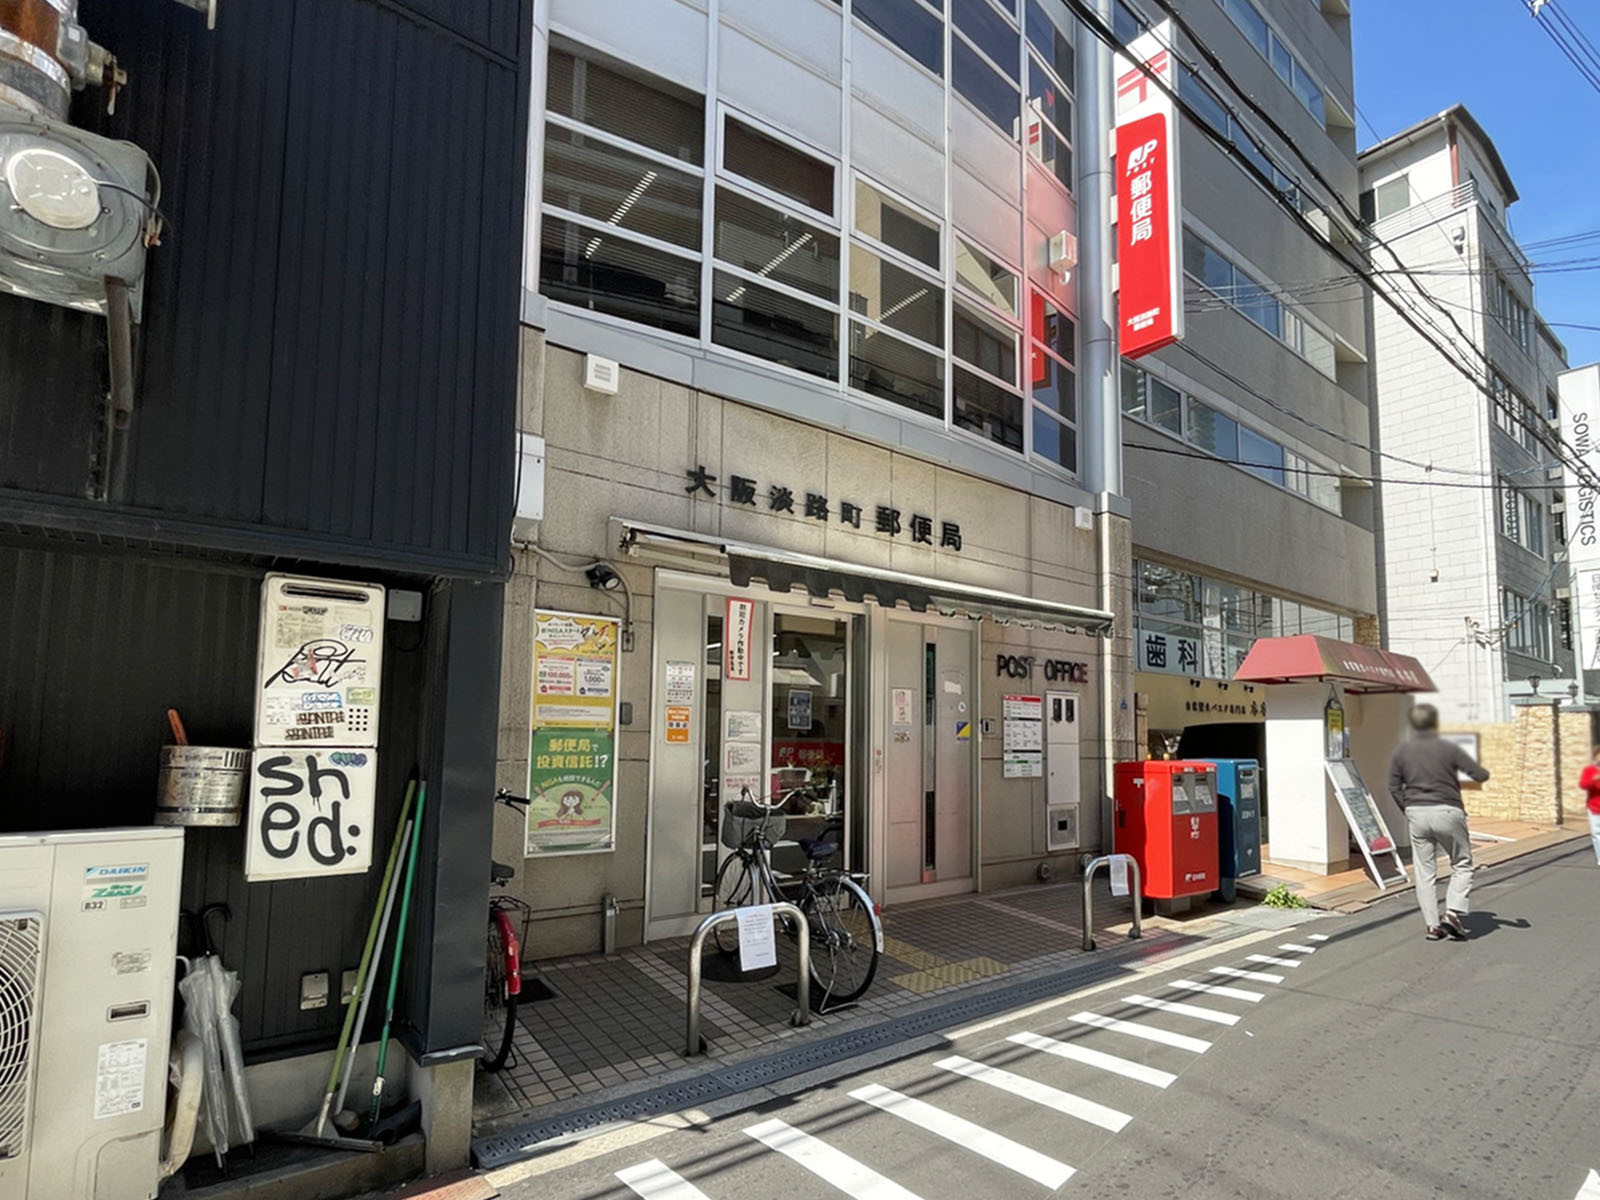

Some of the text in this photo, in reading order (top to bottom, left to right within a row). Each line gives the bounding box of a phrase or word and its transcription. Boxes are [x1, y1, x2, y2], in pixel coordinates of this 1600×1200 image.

[1130, 170, 1153, 246] 郵便局
[1572, 412, 1596, 547] SOWA LOGISTICS
[684, 465, 963, 551] 大阪淡路町郵便局
[996, 654, 1089, 684] POST OFFICE
[1145, 633, 1198, 673] 歯科
[547, 738, 600, 753] 郵便局で
[257, 755, 351, 800] sh
[98, 865, 146, 876] DAIKIN
